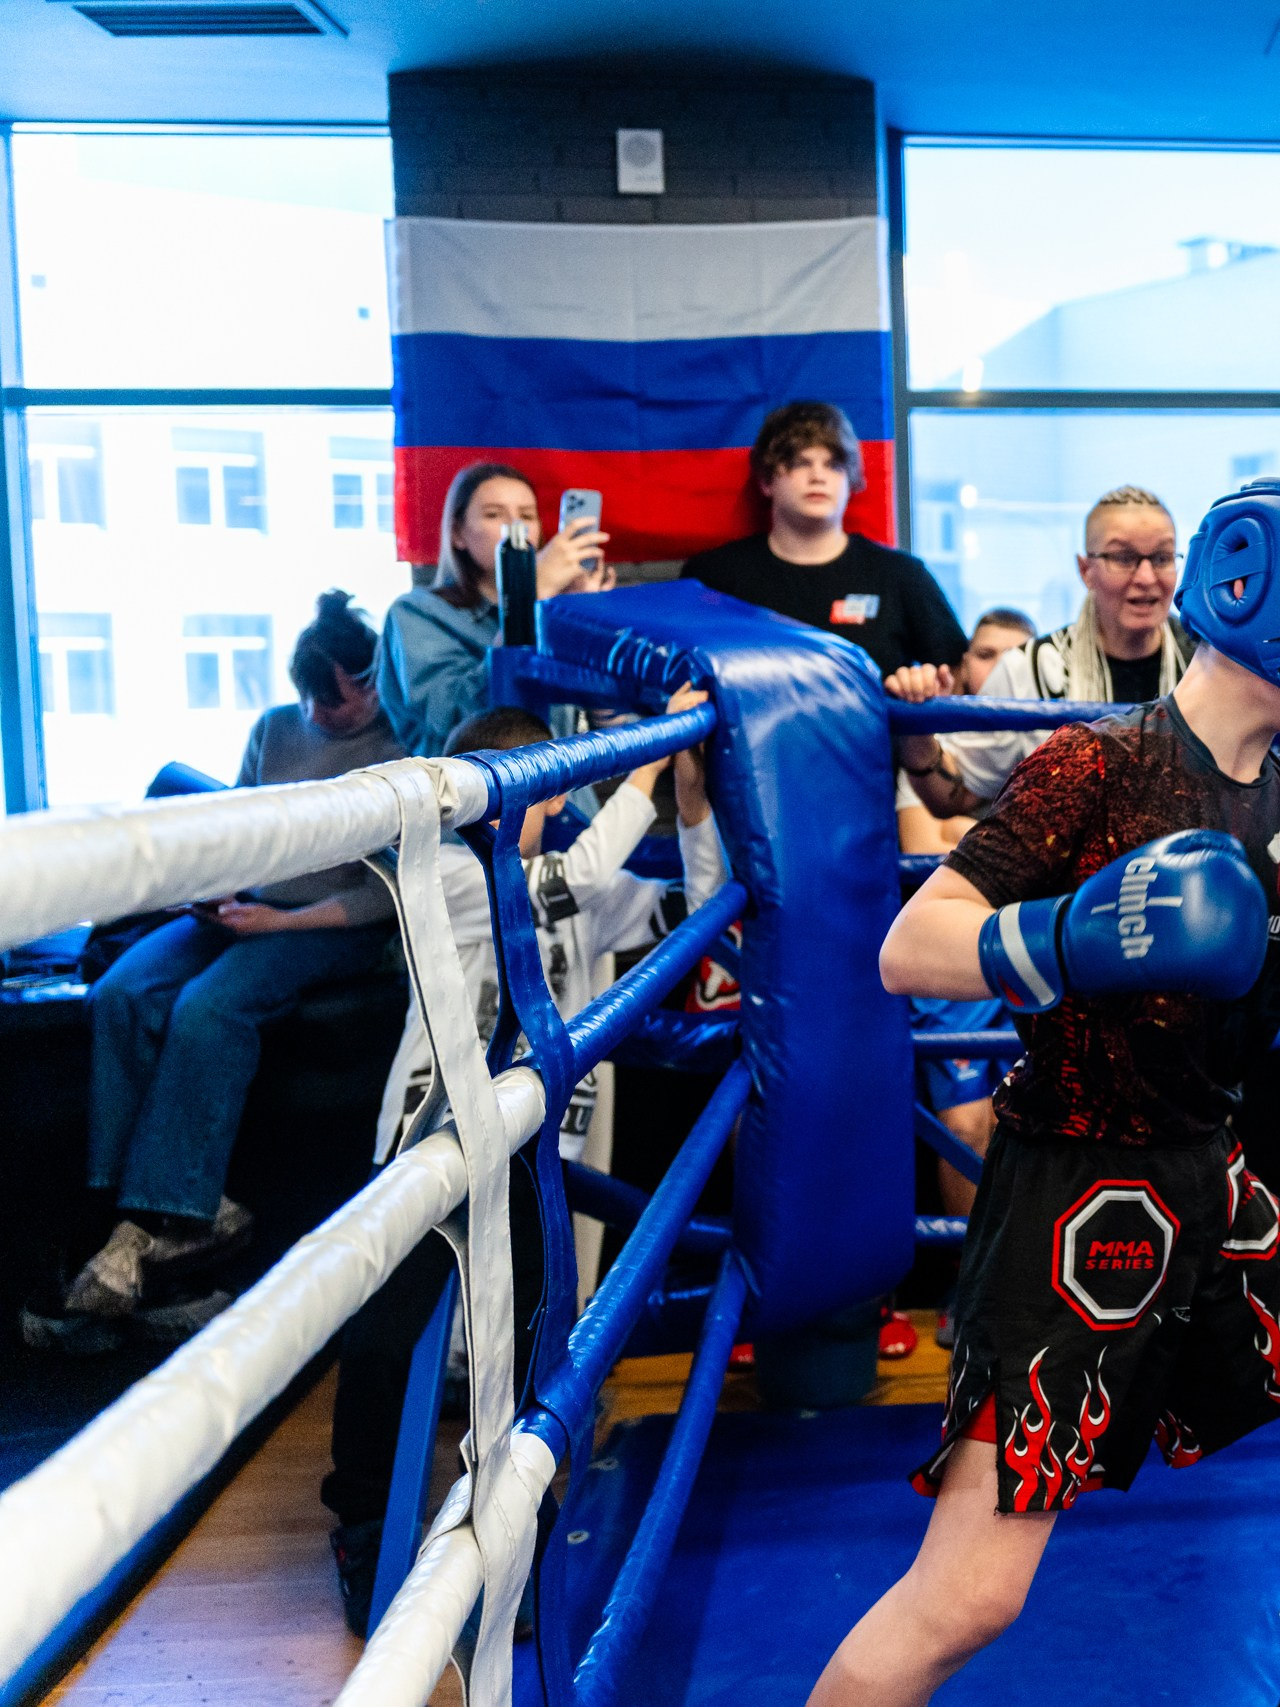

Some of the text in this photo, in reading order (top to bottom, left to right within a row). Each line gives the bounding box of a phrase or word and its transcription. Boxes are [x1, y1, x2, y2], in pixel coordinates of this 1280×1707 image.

[1118, 856, 1159, 960] clinch
[1088, 1240, 1155, 1257] MMA
[1084, 1258, 1155, 1271] SERIES
